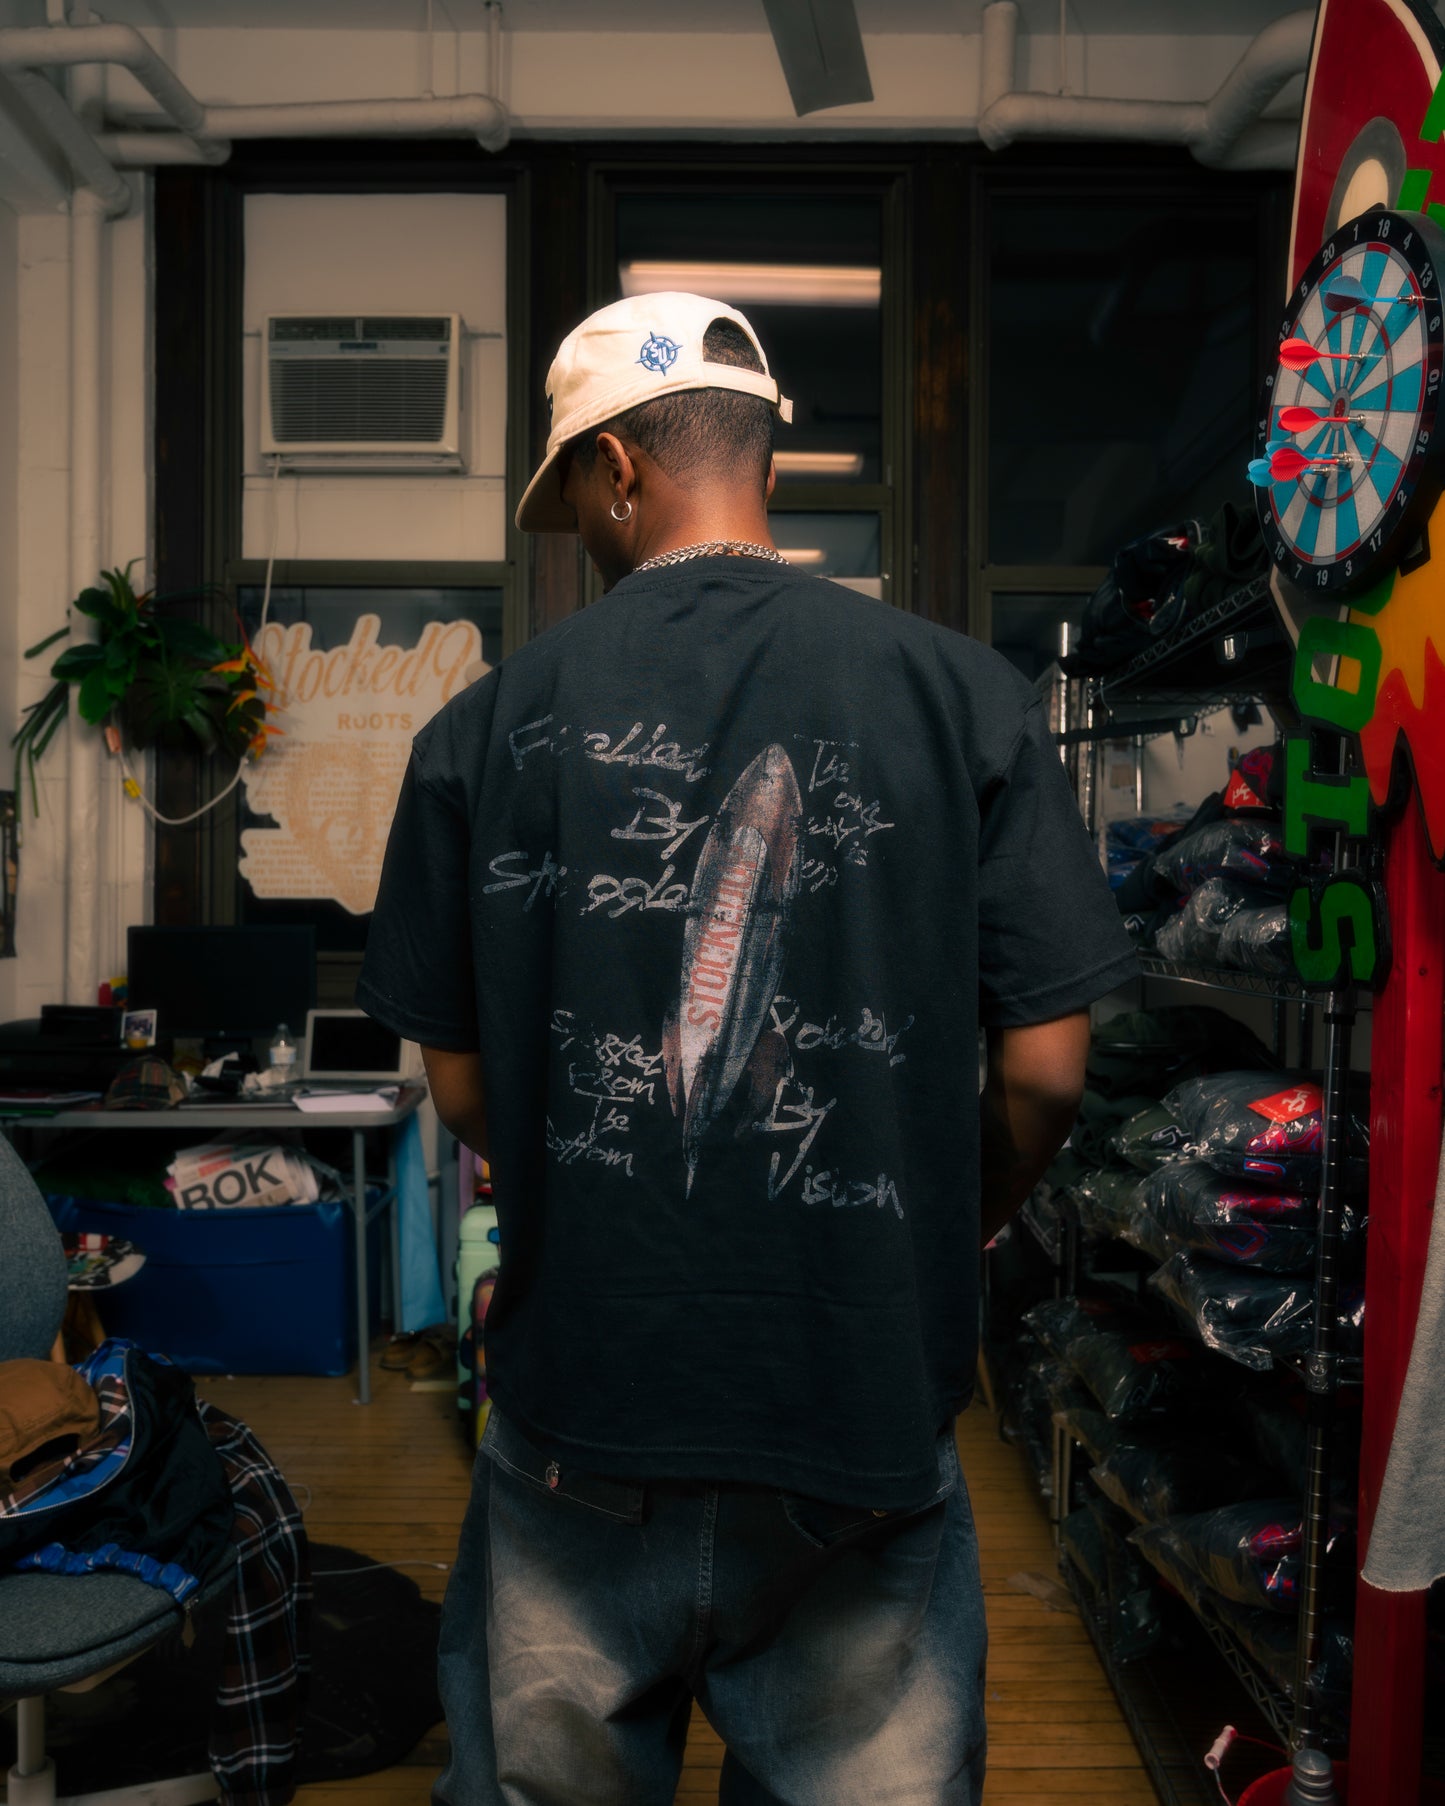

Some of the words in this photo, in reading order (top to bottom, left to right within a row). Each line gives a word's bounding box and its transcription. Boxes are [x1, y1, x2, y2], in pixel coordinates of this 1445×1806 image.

[1353, 225, 1360, 241] 1
[1378, 219, 1391, 239] 18
[1403, 232, 1413, 250] 4
[1322, 243, 1335, 265] 20
[1419, 262, 1433, 288] 13
[1300, 283, 1309, 297] 5
[1280, 321, 1291, 341] 12
[1430, 315, 1440, 332] 6
[1265, 375, 1274, 387] 9
[1428, 368, 1440, 396] 10
[1258, 419, 1267, 440] 14
[1416, 430, 1429, 455] 15
[1396, 491, 1407, 507] 2
[1264, 511, 1272, 525] 8
[1369, 530, 1382, 552] 17
[1274, 541, 1285, 560] 16
[1295, 564, 1303, 579] 7
[1345, 559, 1352, 576] 3
[1316, 569, 1328, 585] 19
[336, 712, 413, 731] ROOTS
